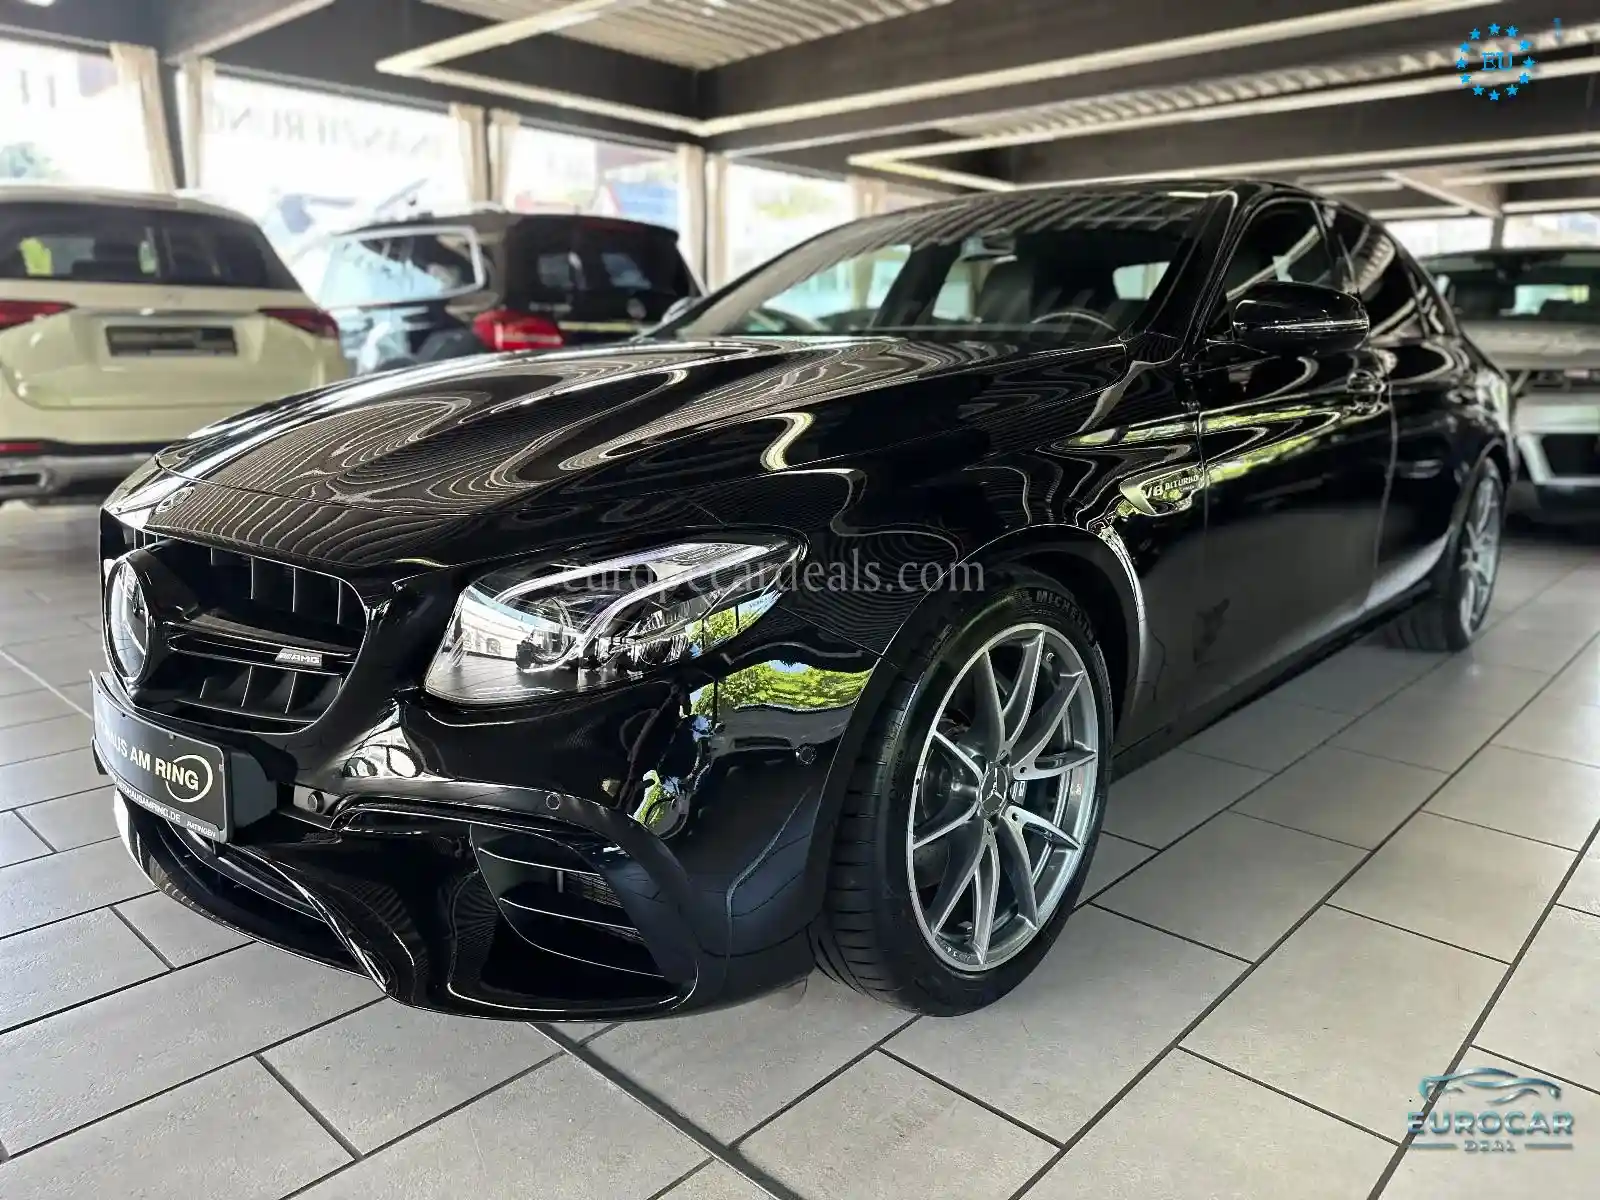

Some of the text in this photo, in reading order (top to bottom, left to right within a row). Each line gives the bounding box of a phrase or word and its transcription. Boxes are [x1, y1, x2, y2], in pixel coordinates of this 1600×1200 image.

[1140, 484, 1164, 499] V8
[1035, 589, 1095, 641] MICHELIN
[130, 746, 151, 772] AM
[155, 757, 199, 791] RING
